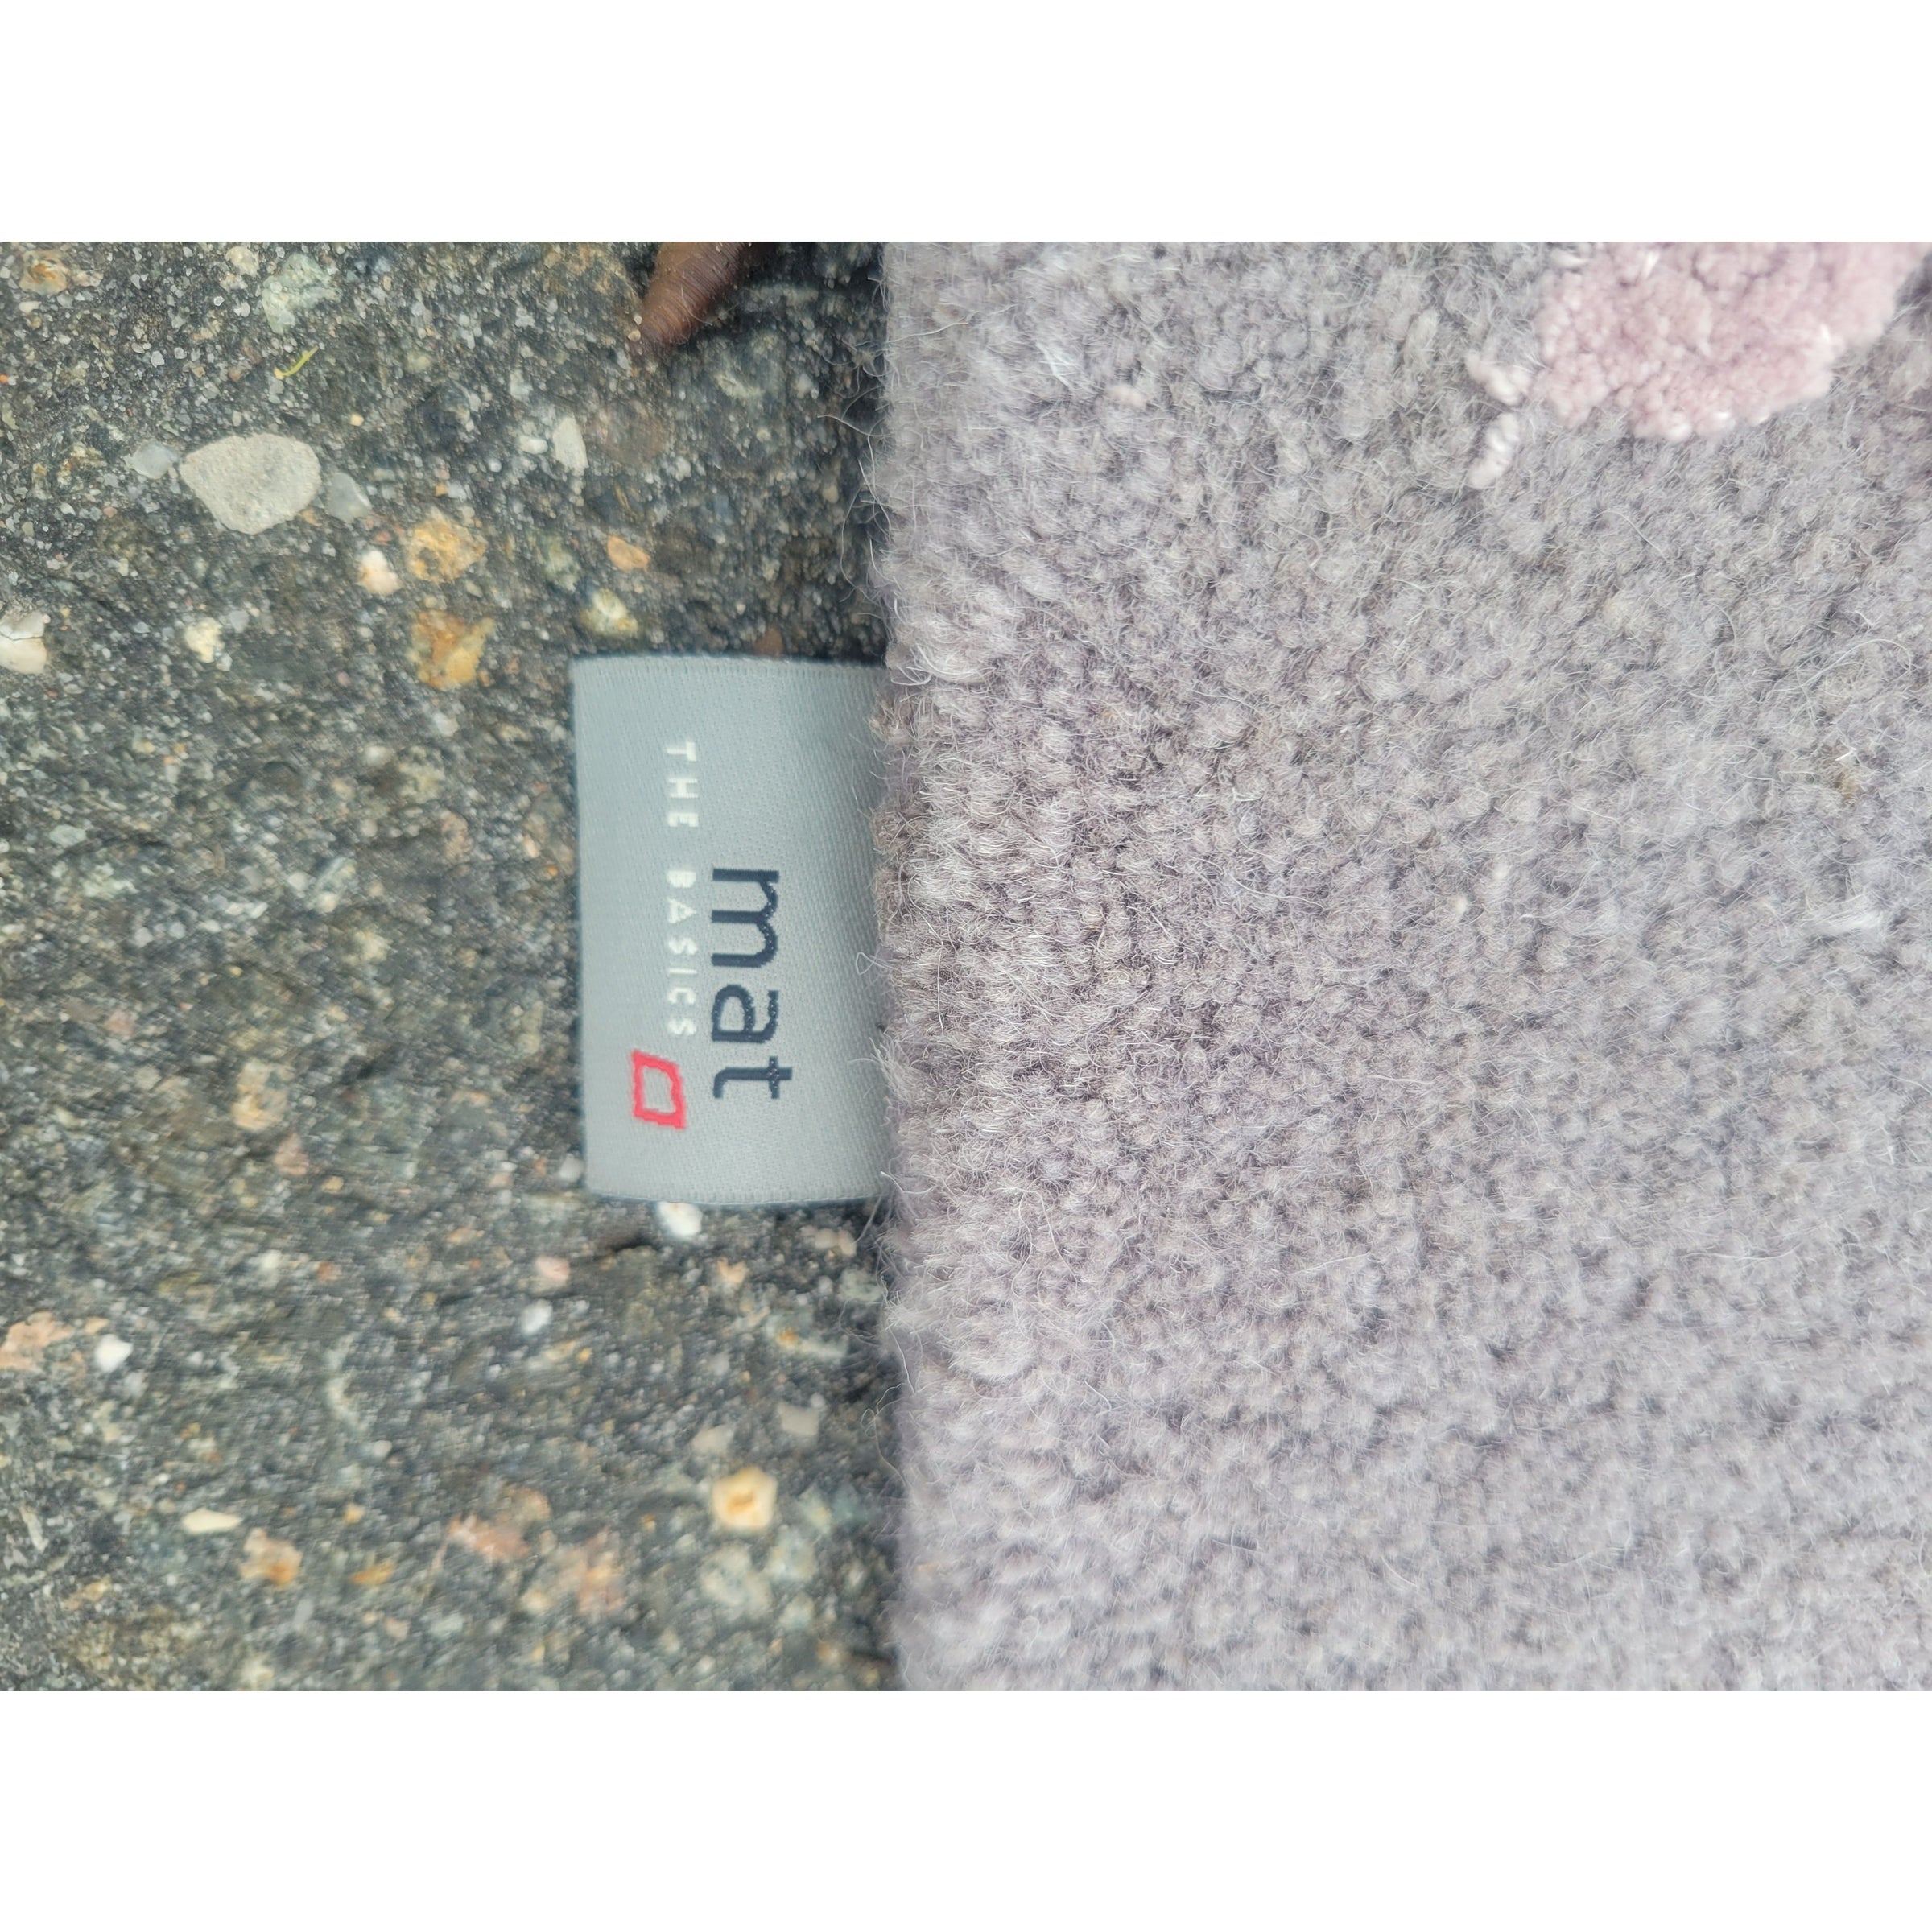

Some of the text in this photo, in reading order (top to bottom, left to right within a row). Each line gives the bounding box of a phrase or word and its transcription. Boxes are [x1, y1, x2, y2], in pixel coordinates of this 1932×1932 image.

[666, 741, 699, 1037] THE BASICS
[710, 867, 793, 1100] mat
